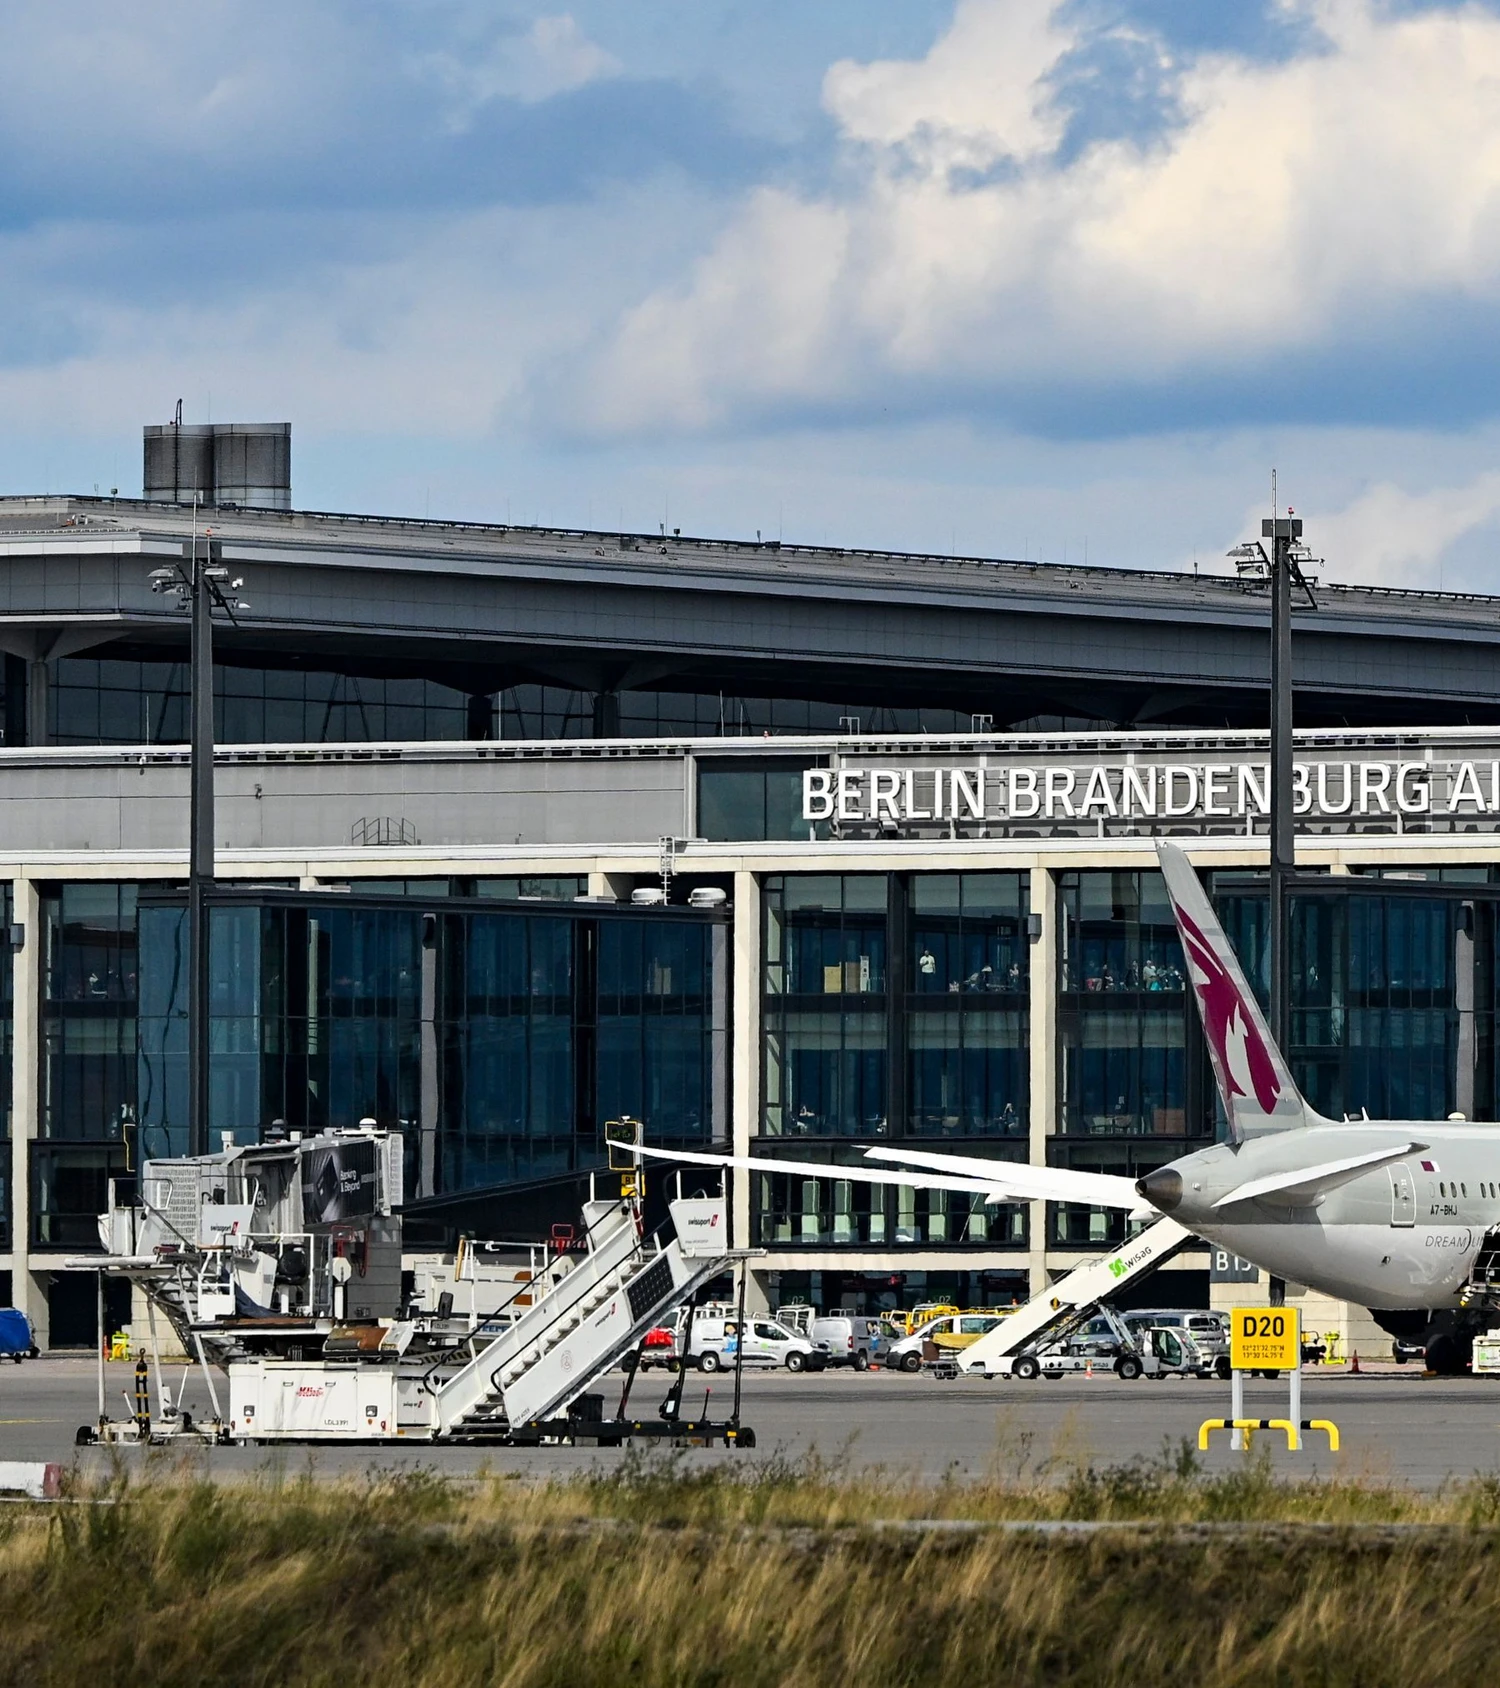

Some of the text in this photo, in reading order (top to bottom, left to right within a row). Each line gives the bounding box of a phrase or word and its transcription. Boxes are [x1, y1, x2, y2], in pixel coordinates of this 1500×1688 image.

[801, 767, 985, 820] BERLIN
[1008, 761, 1429, 819] BRANDENBURG
[1430, 1204, 1458, 1216] A7-BHJ
[1243, 1316, 1285, 1337] D20
